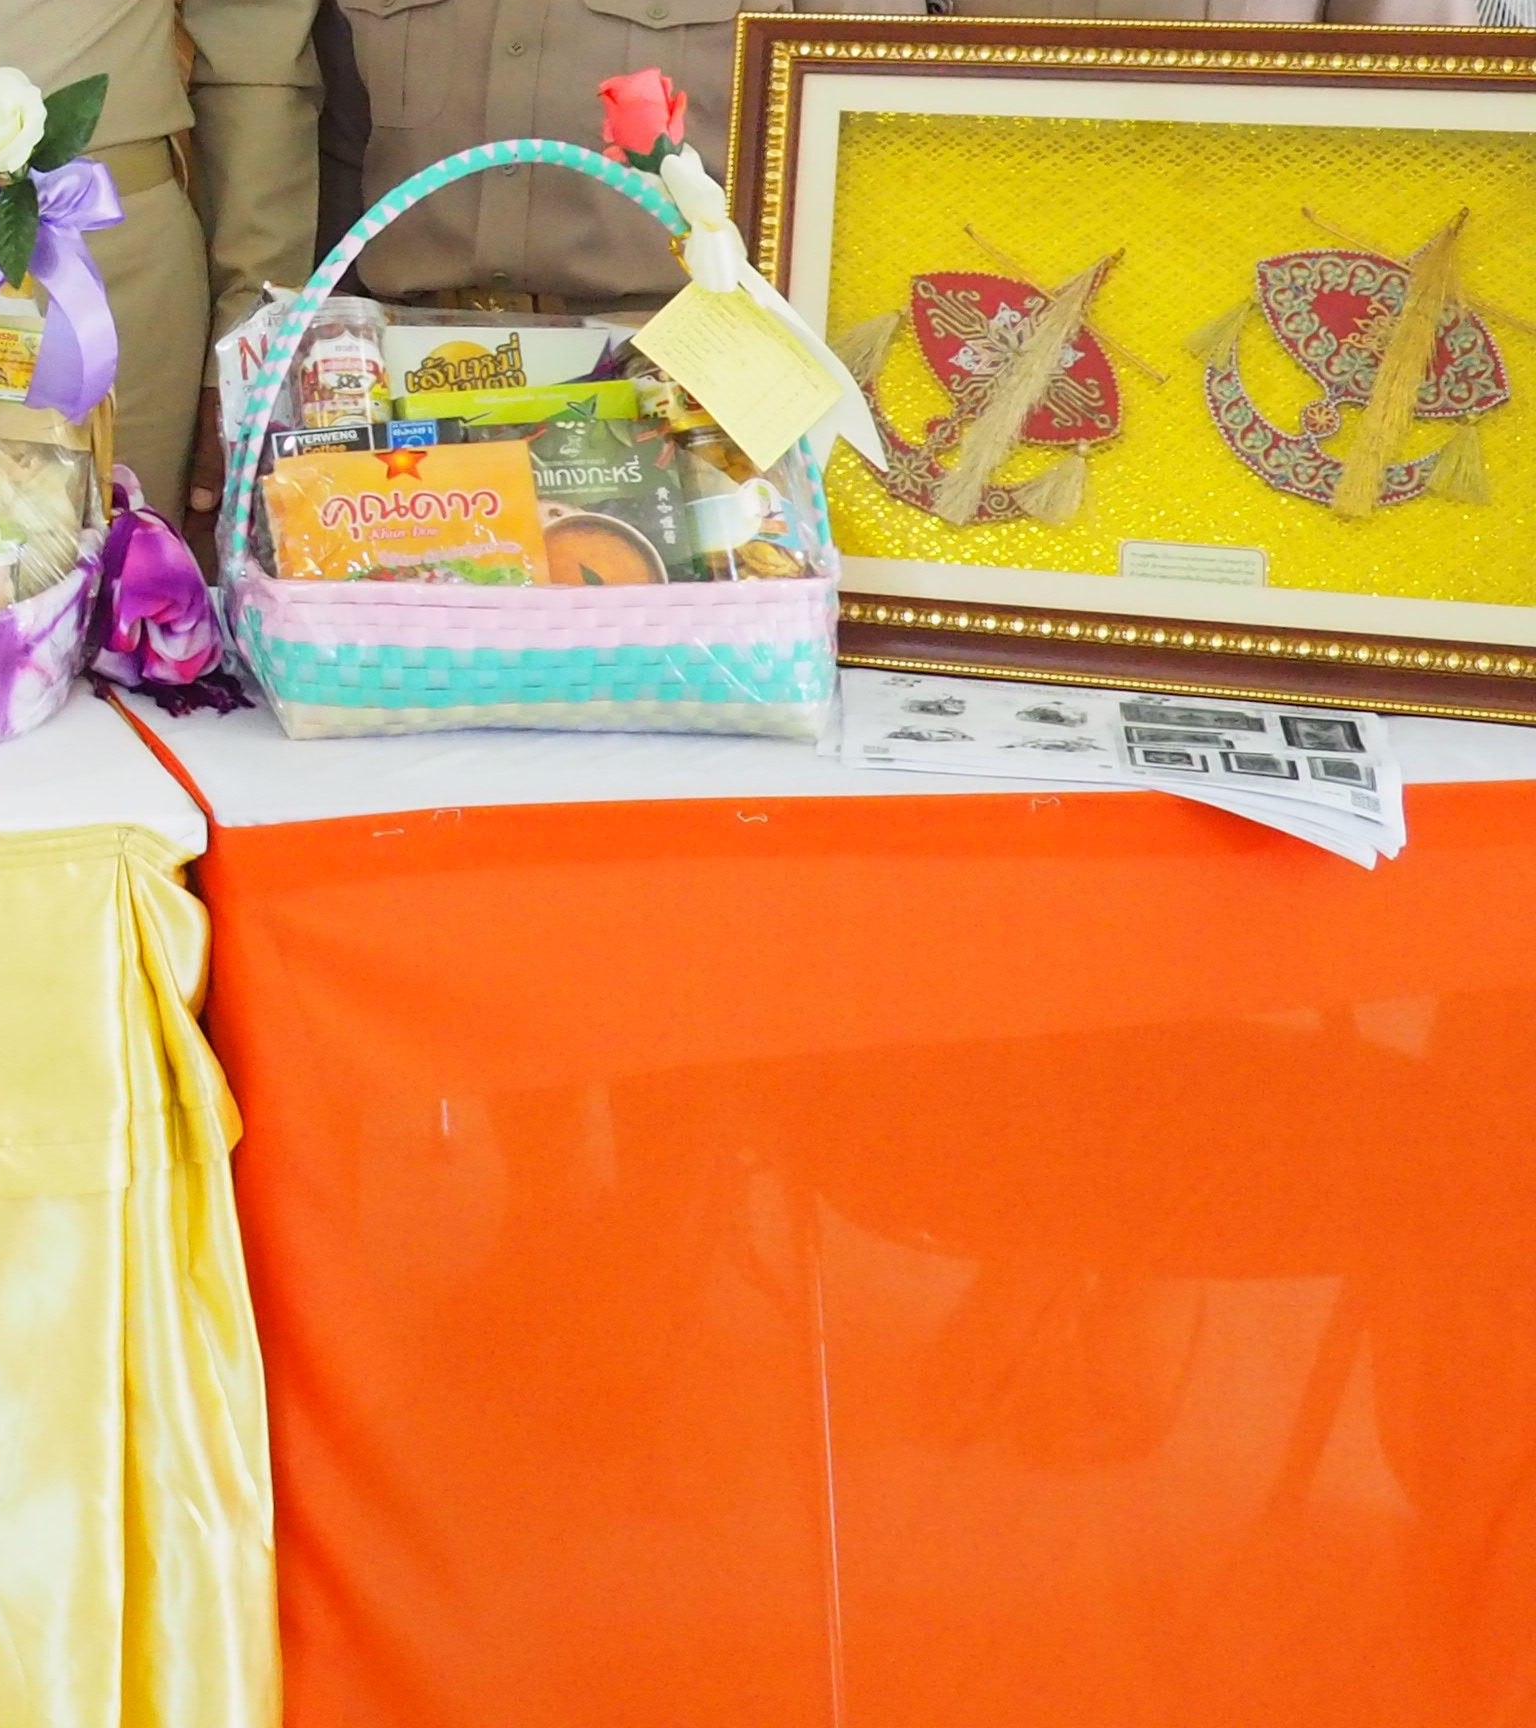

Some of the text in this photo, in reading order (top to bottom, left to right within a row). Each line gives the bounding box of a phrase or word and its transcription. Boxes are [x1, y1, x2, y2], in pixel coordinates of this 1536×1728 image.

[405, 332, 524, 394] เส้นหมี่
[297, 429, 359, 445] YERWENG
[321, 491, 501, 541] คุณดาว
